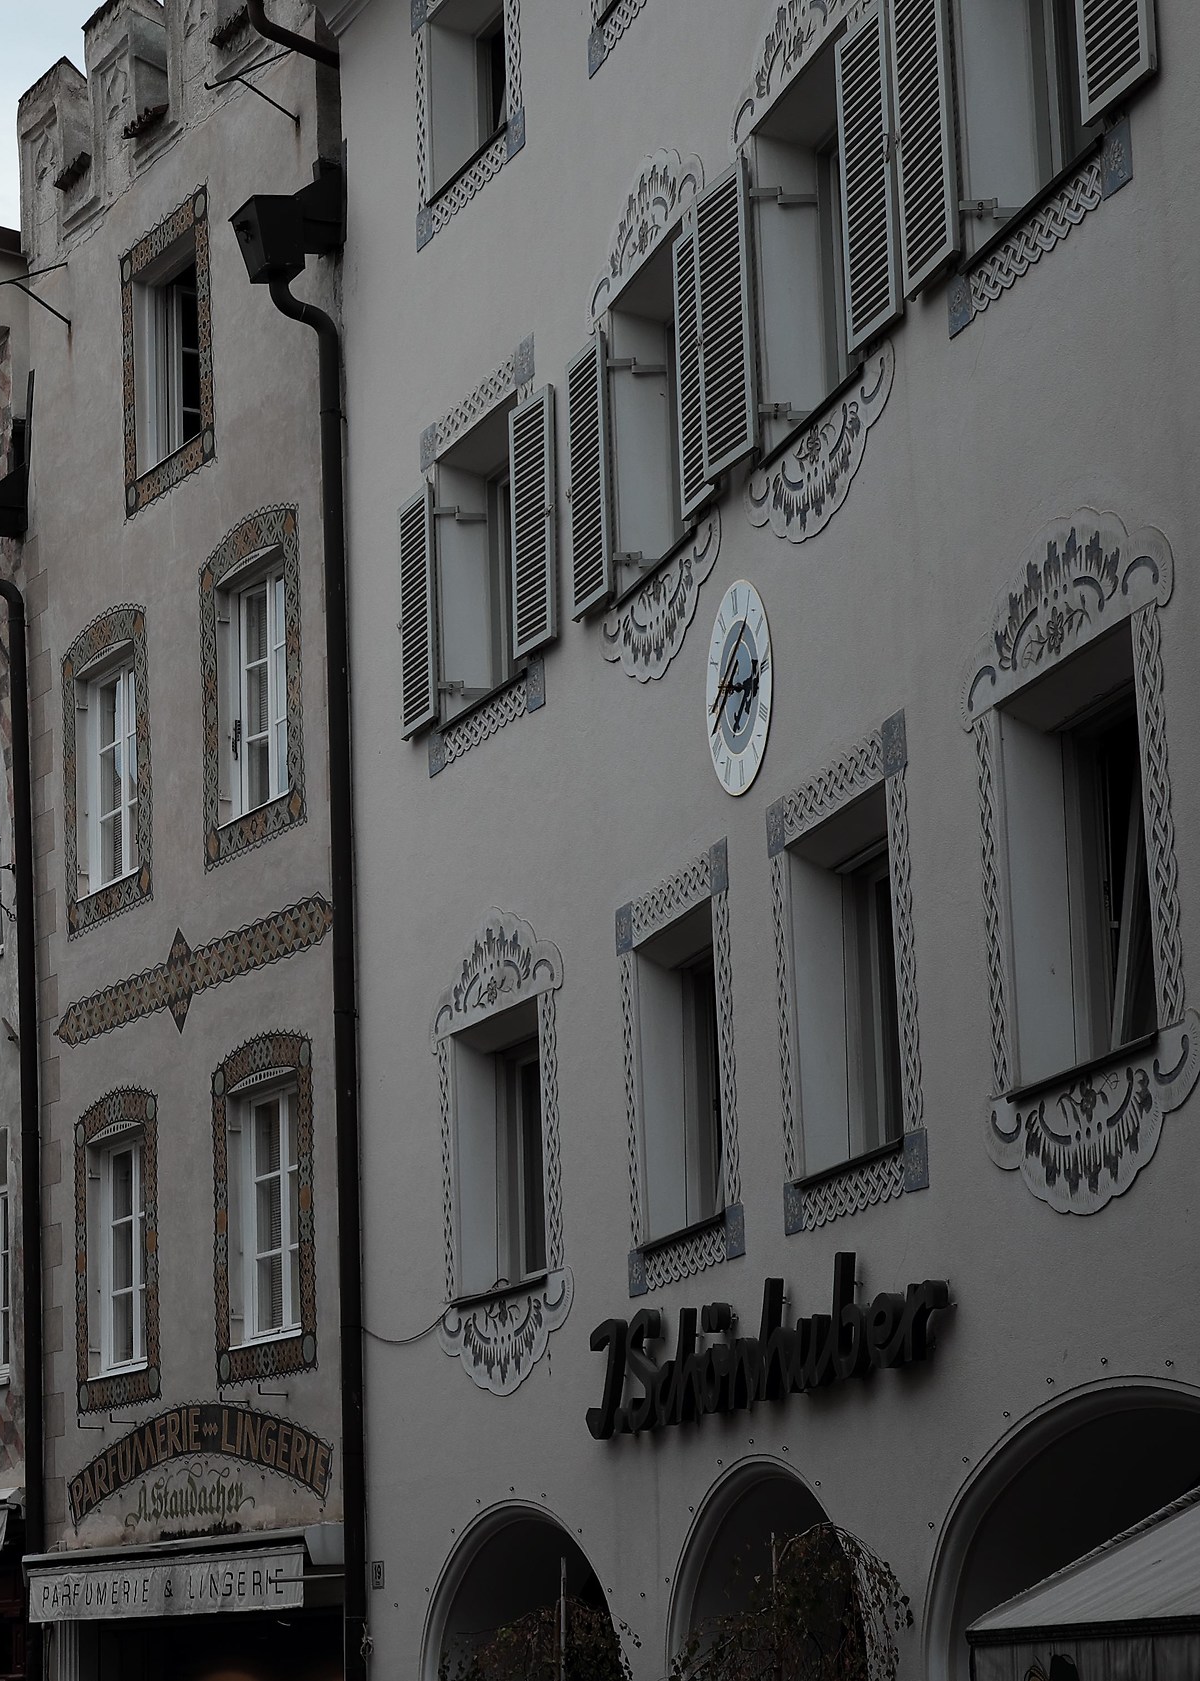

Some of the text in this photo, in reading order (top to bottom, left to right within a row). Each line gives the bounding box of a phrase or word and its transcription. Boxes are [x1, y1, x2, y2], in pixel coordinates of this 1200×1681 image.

[221, 1408, 330, 1497] LINGERIE
[374, 1564, 382, 1580] 19
[42, 1579, 149, 1608] PARFUMERIE
[164, 1579, 174, 1598] &
